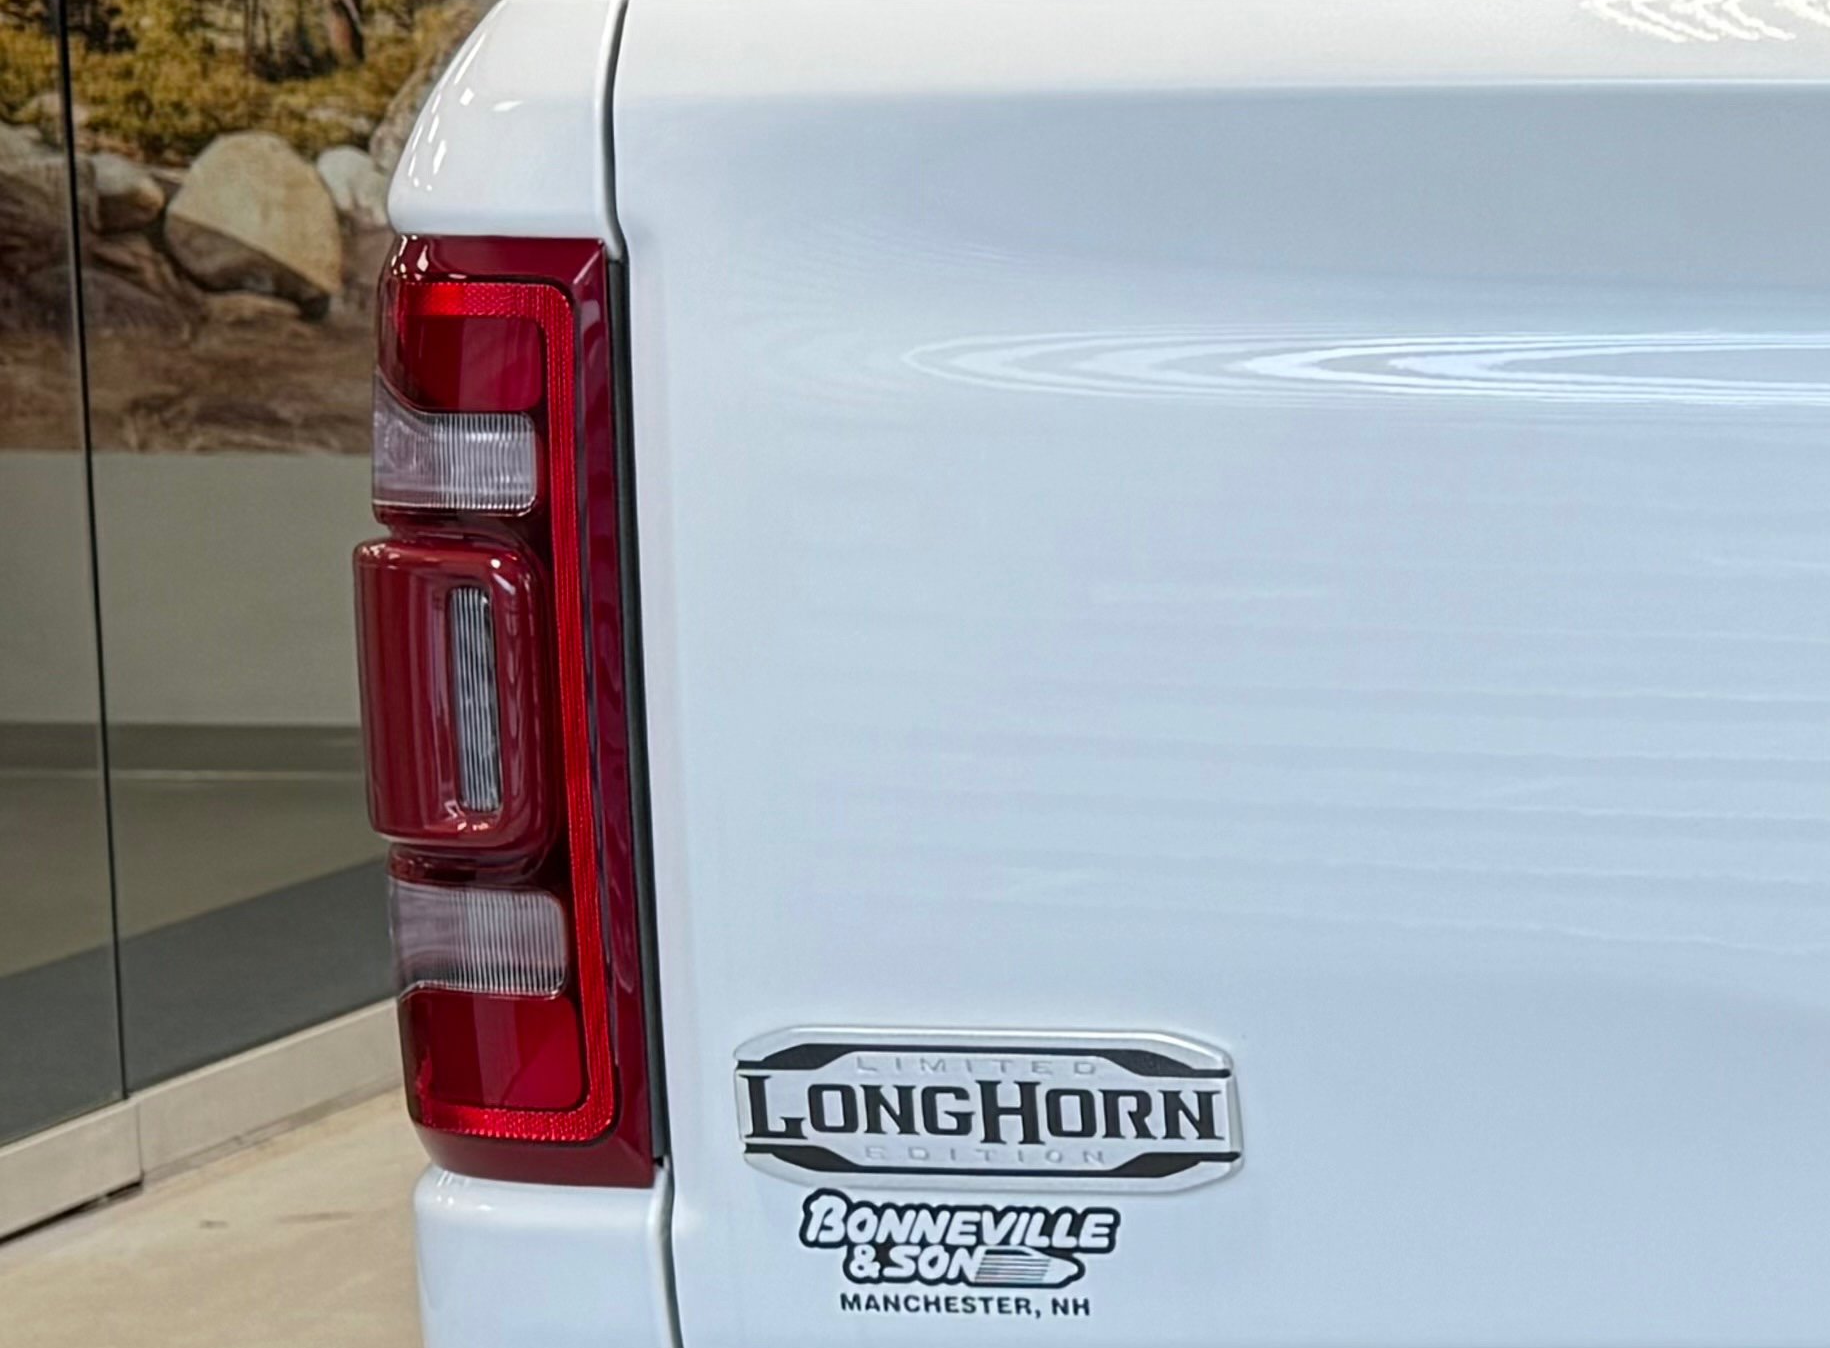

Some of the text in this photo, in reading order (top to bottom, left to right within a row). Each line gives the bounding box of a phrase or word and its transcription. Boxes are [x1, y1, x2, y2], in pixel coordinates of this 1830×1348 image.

[856, 1056, 1098, 1077] LIMITED
[864, 1145, 1107, 1165] EDITION
[803, 1191, 1118, 1250] BONNEVILLE
[848, 1244, 984, 1283] & SON
[840, 1292, 1091, 1319] MANCHESTER, NH
